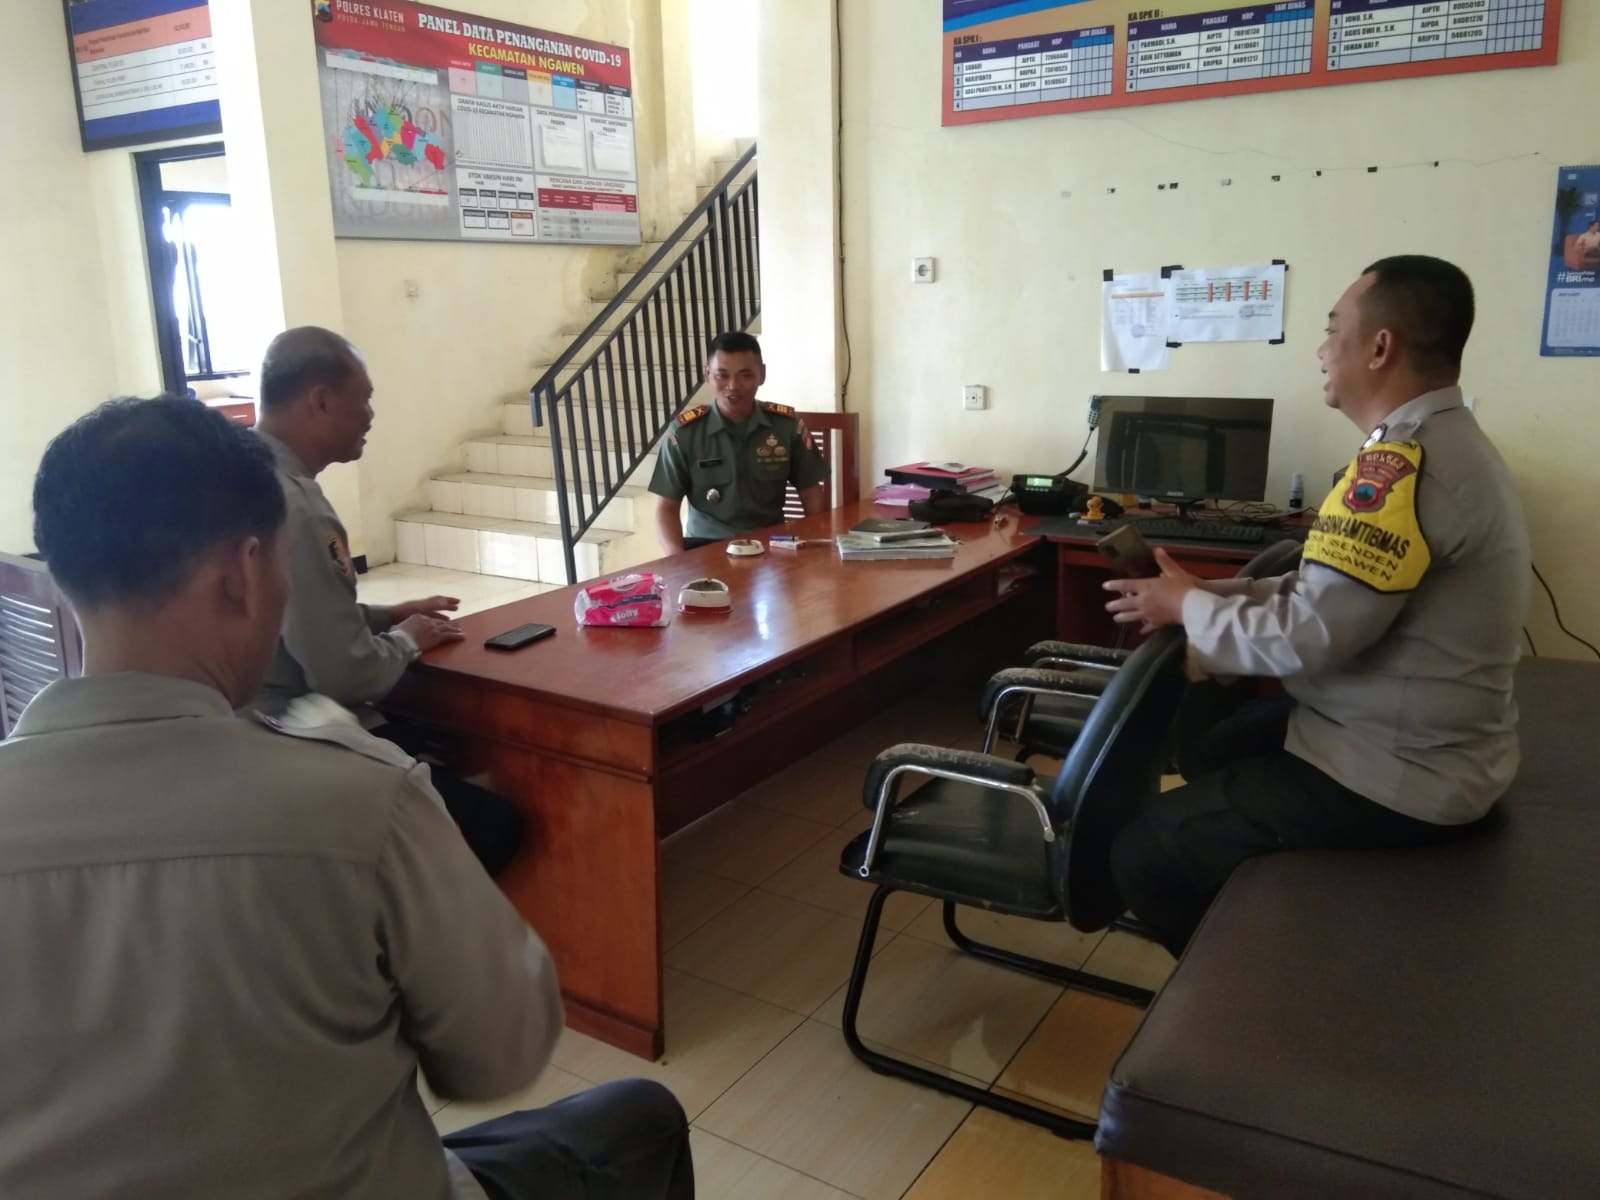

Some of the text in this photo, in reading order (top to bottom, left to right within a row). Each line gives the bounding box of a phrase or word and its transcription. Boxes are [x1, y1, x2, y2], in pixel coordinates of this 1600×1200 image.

[336, 0, 404, 23] POLRES KLATEN
[1128, 12, 1137, 21] KA
[1139, 10, 1153, 20] SPK
[418, 13, 622, 67] PANEL DATA PENANGANAN COVID-19
[468, 43, 585, 76] KECAMATAN NGAWEN
[1321, 548, 1392, 582] NGAWEN
[1330, 540, 1398, 571] SENDEN
